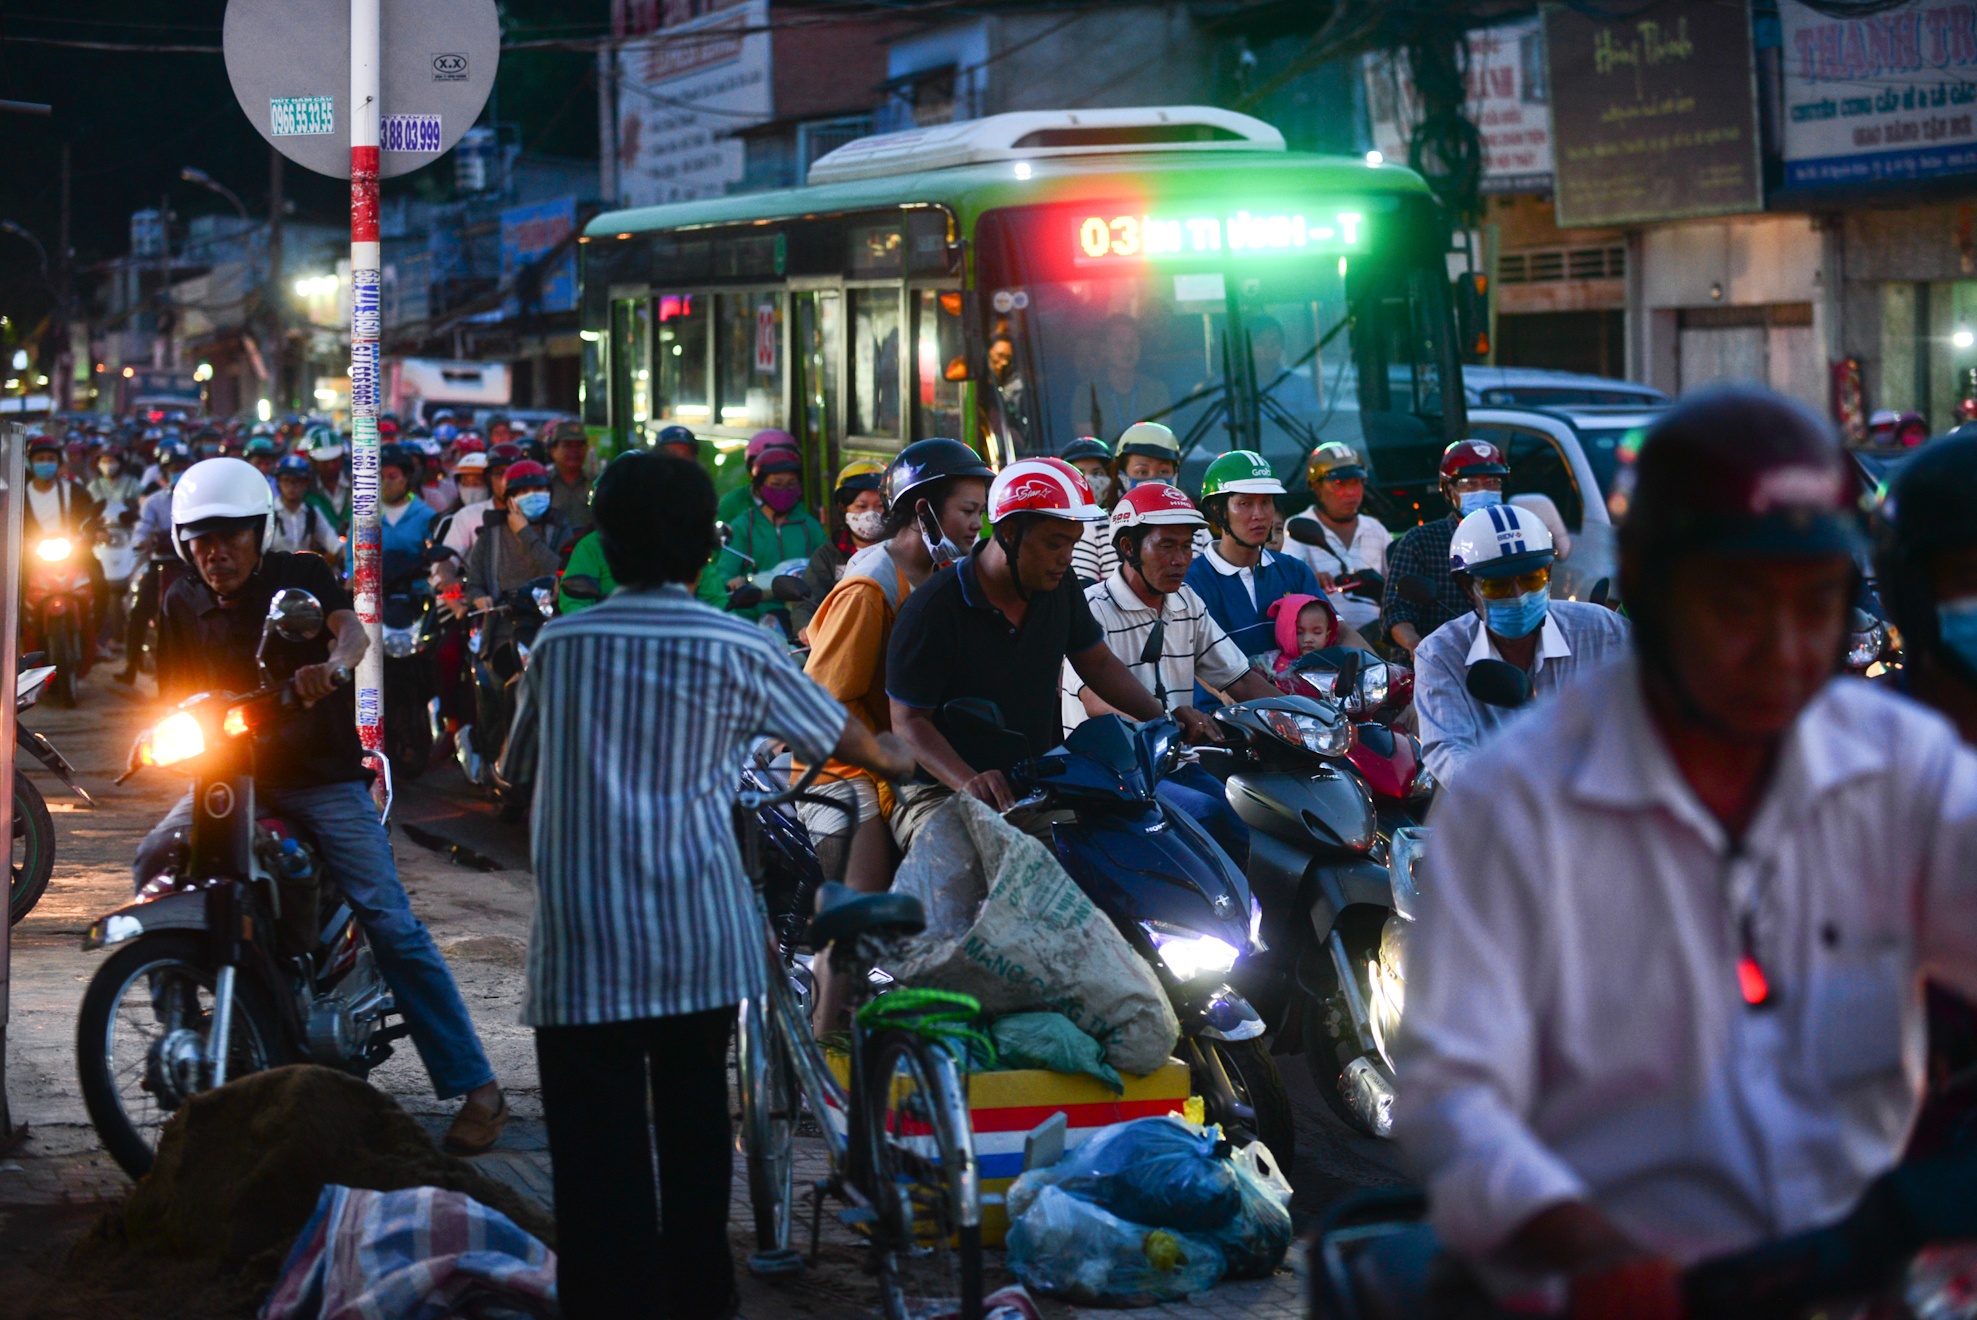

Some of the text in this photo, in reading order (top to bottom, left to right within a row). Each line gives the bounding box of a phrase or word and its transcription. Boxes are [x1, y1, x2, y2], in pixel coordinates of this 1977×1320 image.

[439, 59, 461, 68] X.X
[1080, 216, 1140, 256] 03
[1252, 468, 1271, 476] Grab
[1497, 532, 1516, 541] BIDV
